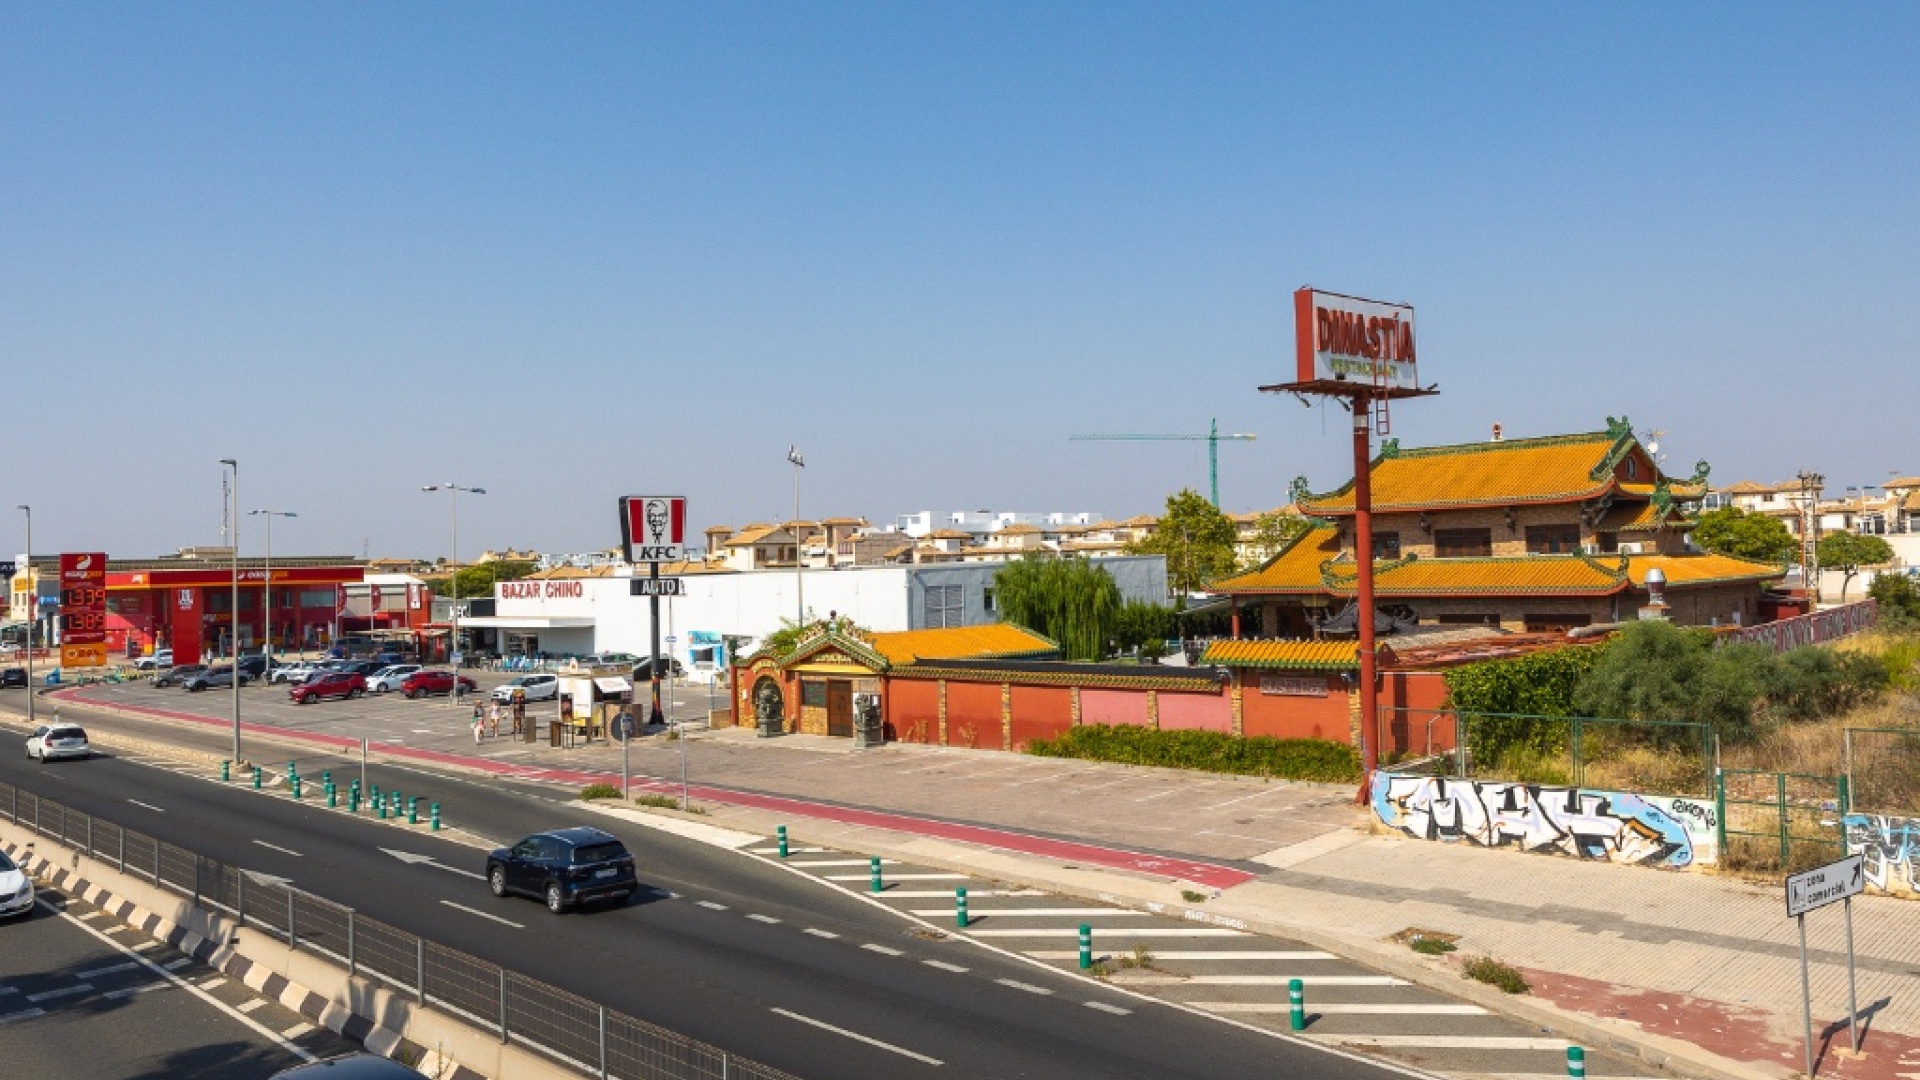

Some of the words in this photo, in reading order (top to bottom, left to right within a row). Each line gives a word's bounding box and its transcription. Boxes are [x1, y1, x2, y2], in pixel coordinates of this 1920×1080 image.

[1317, 307, 1415, 363] DINASTÍA
[640, 546, 676, 559] KFC
[502, 582, 540, 599] BAZAR
[545, 581, 583, 599] CHINO
[642, 580, 676, 594] AUTO
[1807, 874, 1825, 887] zona
[1808, 880, 1845, 904] comercial
